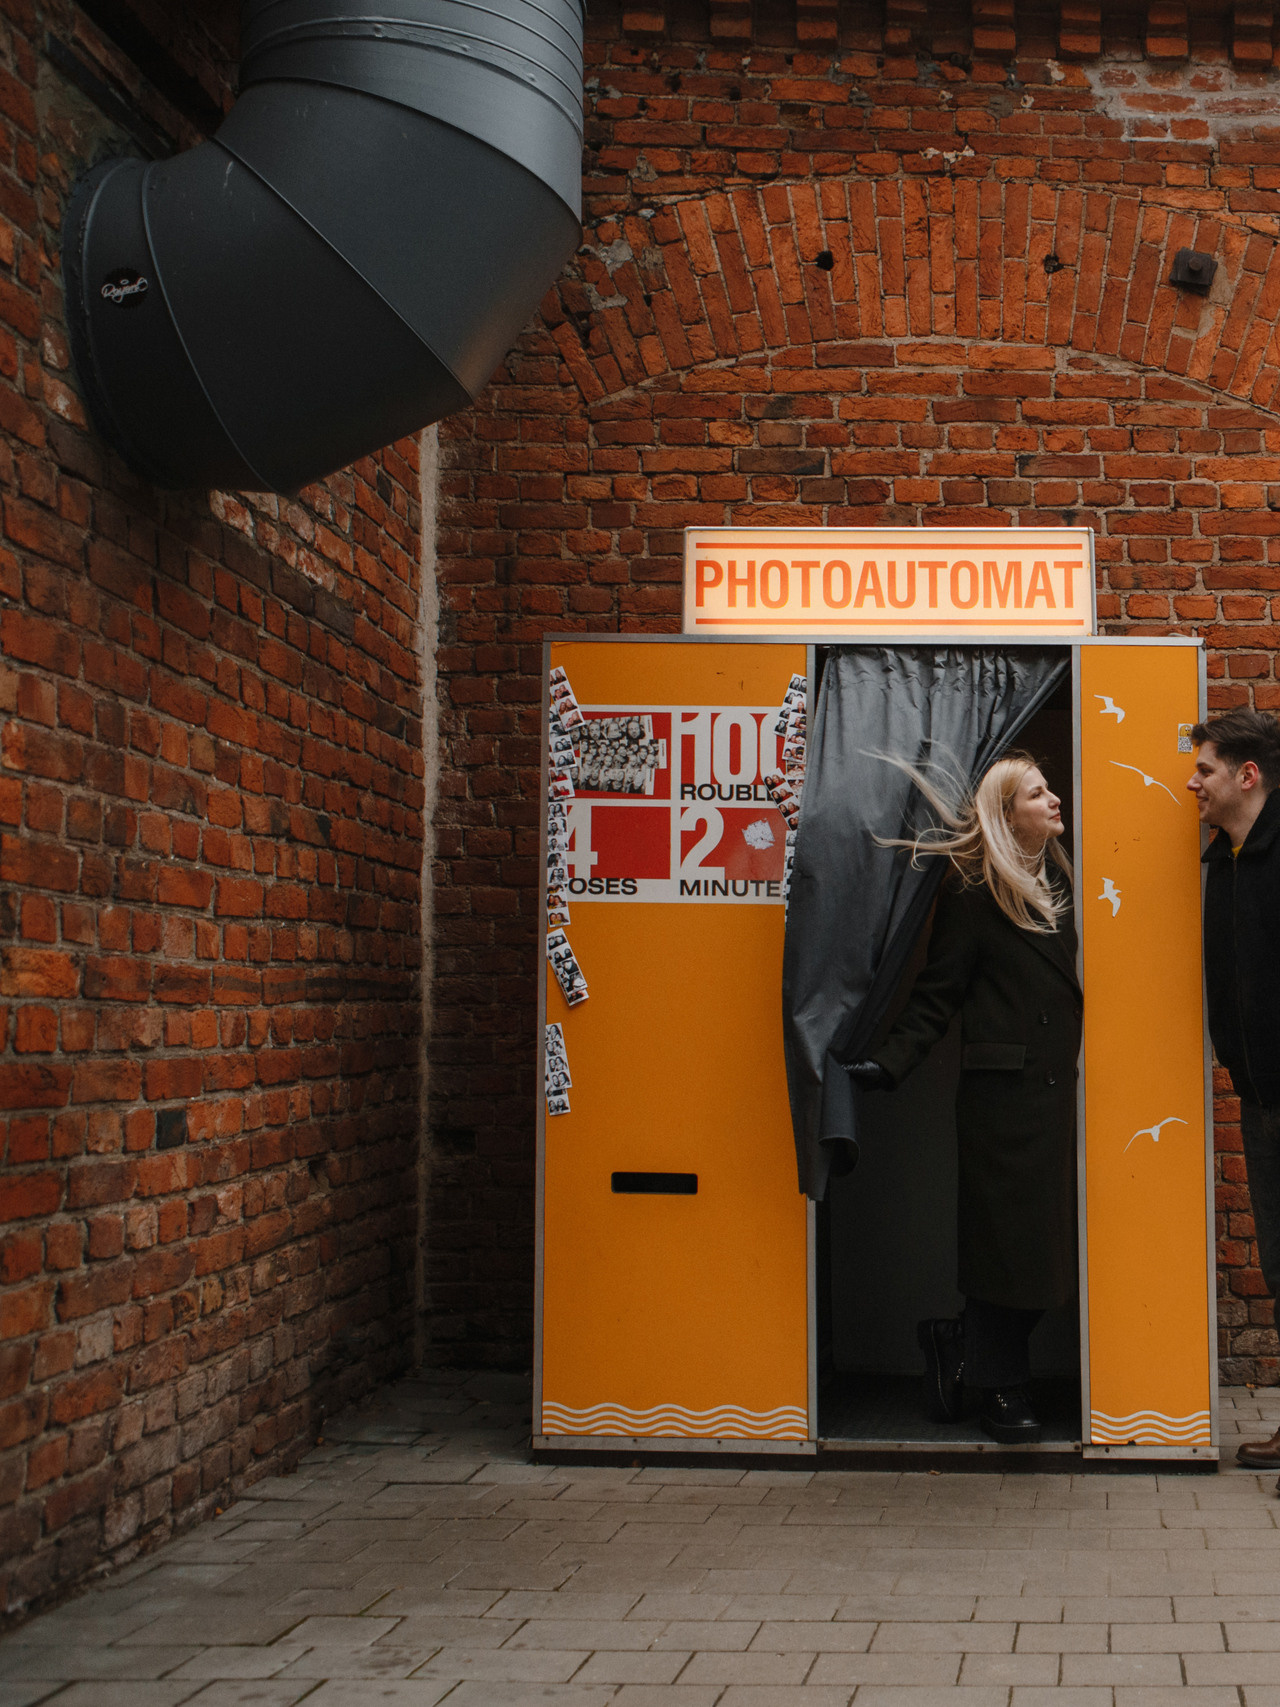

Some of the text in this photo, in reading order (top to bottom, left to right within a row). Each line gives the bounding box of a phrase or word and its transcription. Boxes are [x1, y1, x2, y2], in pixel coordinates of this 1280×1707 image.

[695, 559, 1083, 609] PHOTOAUTOMAT
[567, 804, 598, 879] 4
[681, 806, 725, 880] 2
[565, 877, 638, 896] OSES
